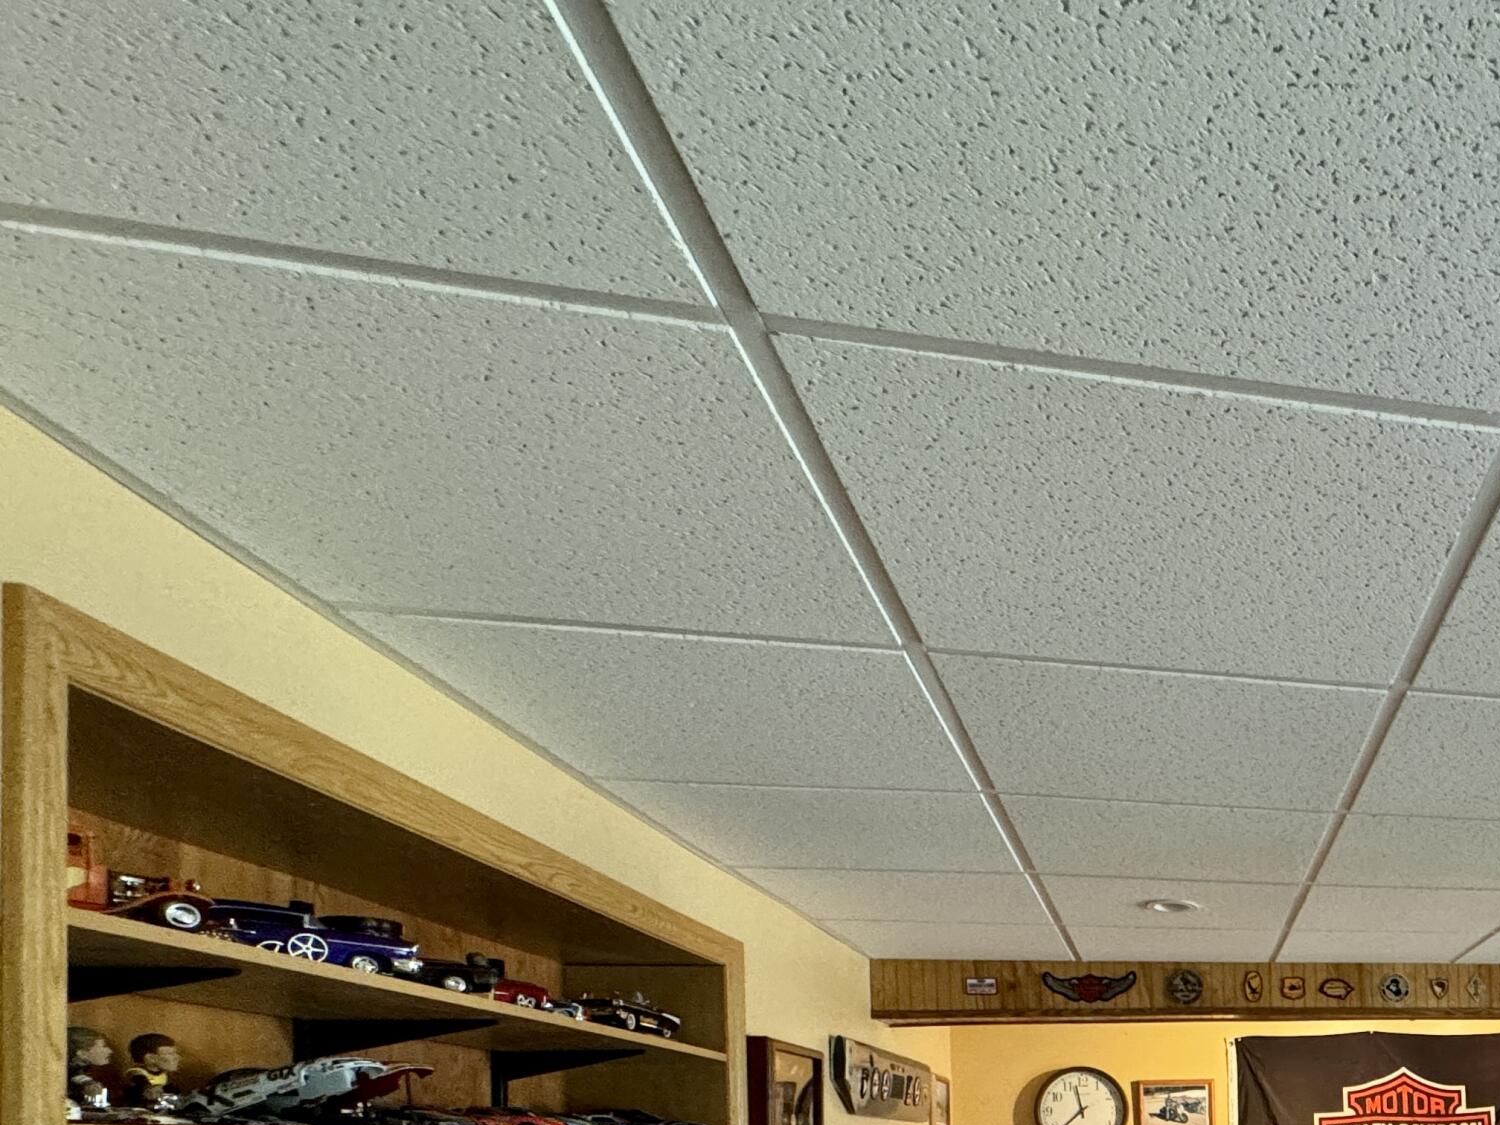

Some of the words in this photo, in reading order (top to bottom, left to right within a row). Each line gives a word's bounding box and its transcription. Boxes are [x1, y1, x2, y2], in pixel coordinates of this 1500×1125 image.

[1078, 1076, 1088, 1087] 12
[1052, 1091, 1063, 1102] 10
[1365, 1086, 1446, 1115] MOTOR
